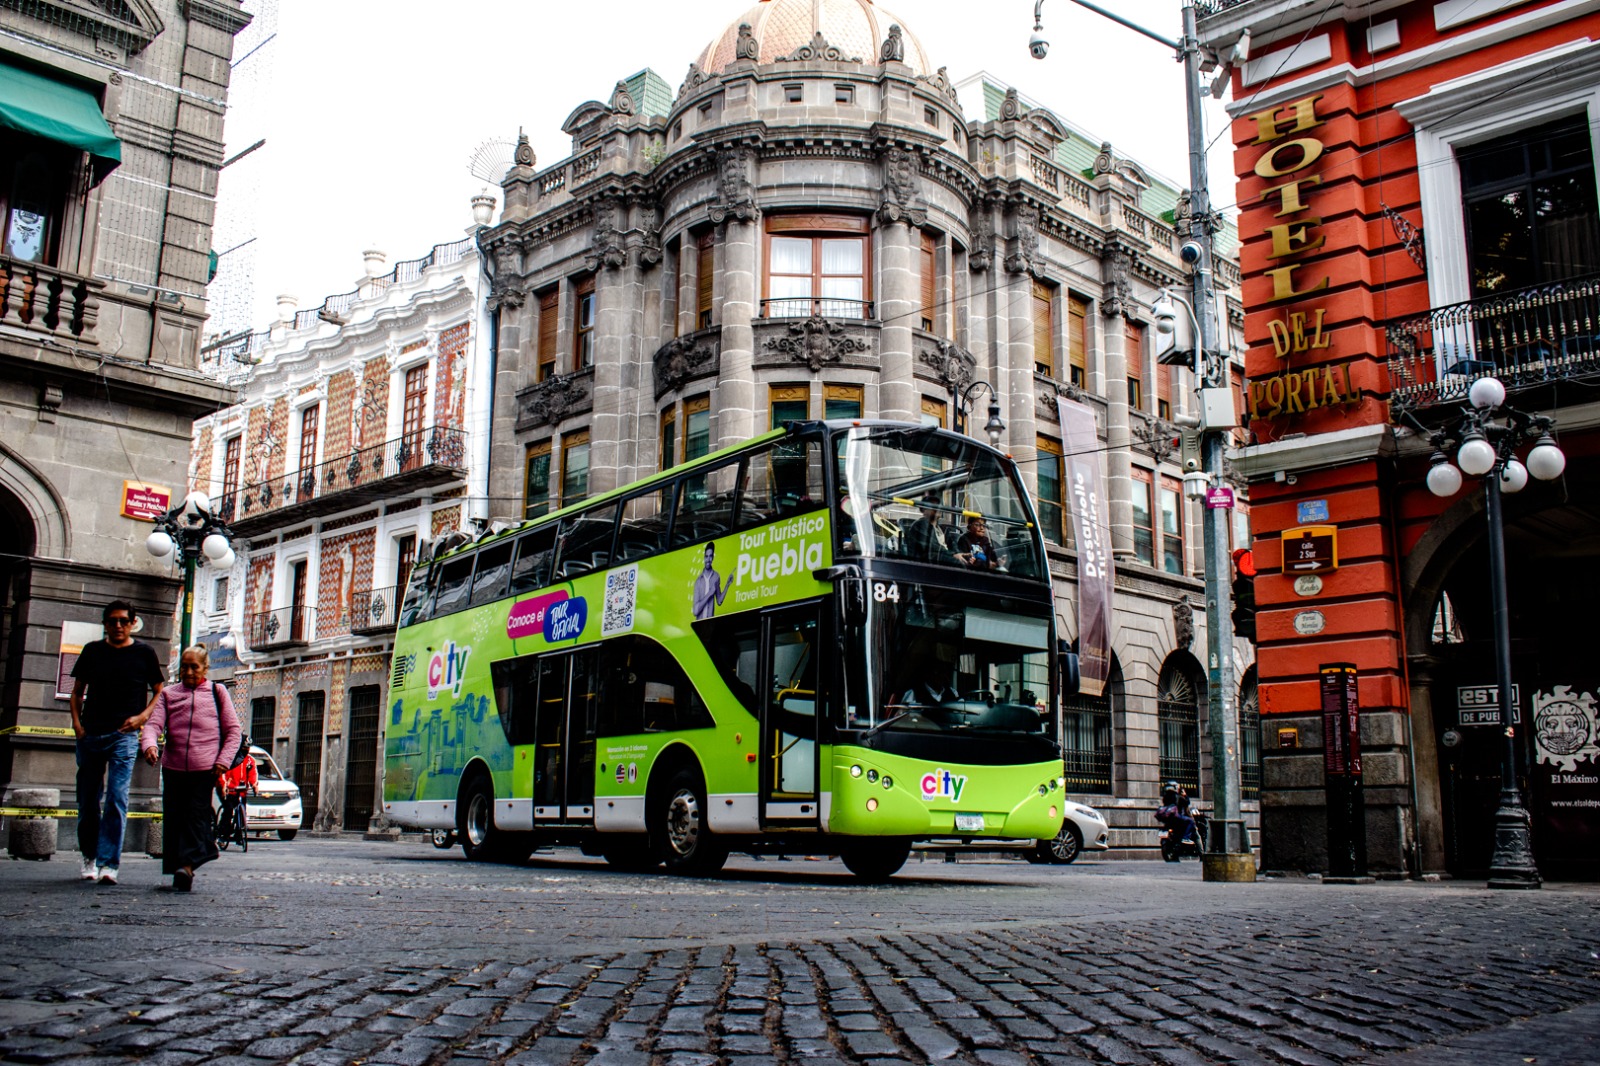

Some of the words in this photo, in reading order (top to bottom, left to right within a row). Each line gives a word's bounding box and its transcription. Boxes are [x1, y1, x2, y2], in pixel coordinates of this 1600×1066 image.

[1248, 94, 1329, 301] HOTEL
[1266, 308, 1331, 359] DEL
[1249, 363, 1363, 420] PORTAL
[739, 532, 767, 551] Tour
[769, 517, 825, 543] Turístico
[1074, 473, 1097, 577] Desarrollo
[1299, 551, 1304, 559] 2
[1305, 551, 1316, 559] Sur
[1301, 542, 1314, 550] Calle
[735, 538, 823, 586] Puebla
[735, 587, 759, 602] Travel
[760, 585, 778, 598] Tour
[873, 583, 900, 603] 84
[507, 612, 536, 629] Conoce
[536, 607, 546, 622] el
[550, 601, 569, 625] TOUR
[552, 612, 580, 641] OFICIAL
[428, 643, 468, 694] city
[1462, 712, 1475, 722] DE
[922, 769, 965, 801] city
[1551, 774, 1561, 784] El
[1562, 773, 1599, 784] Máximo
